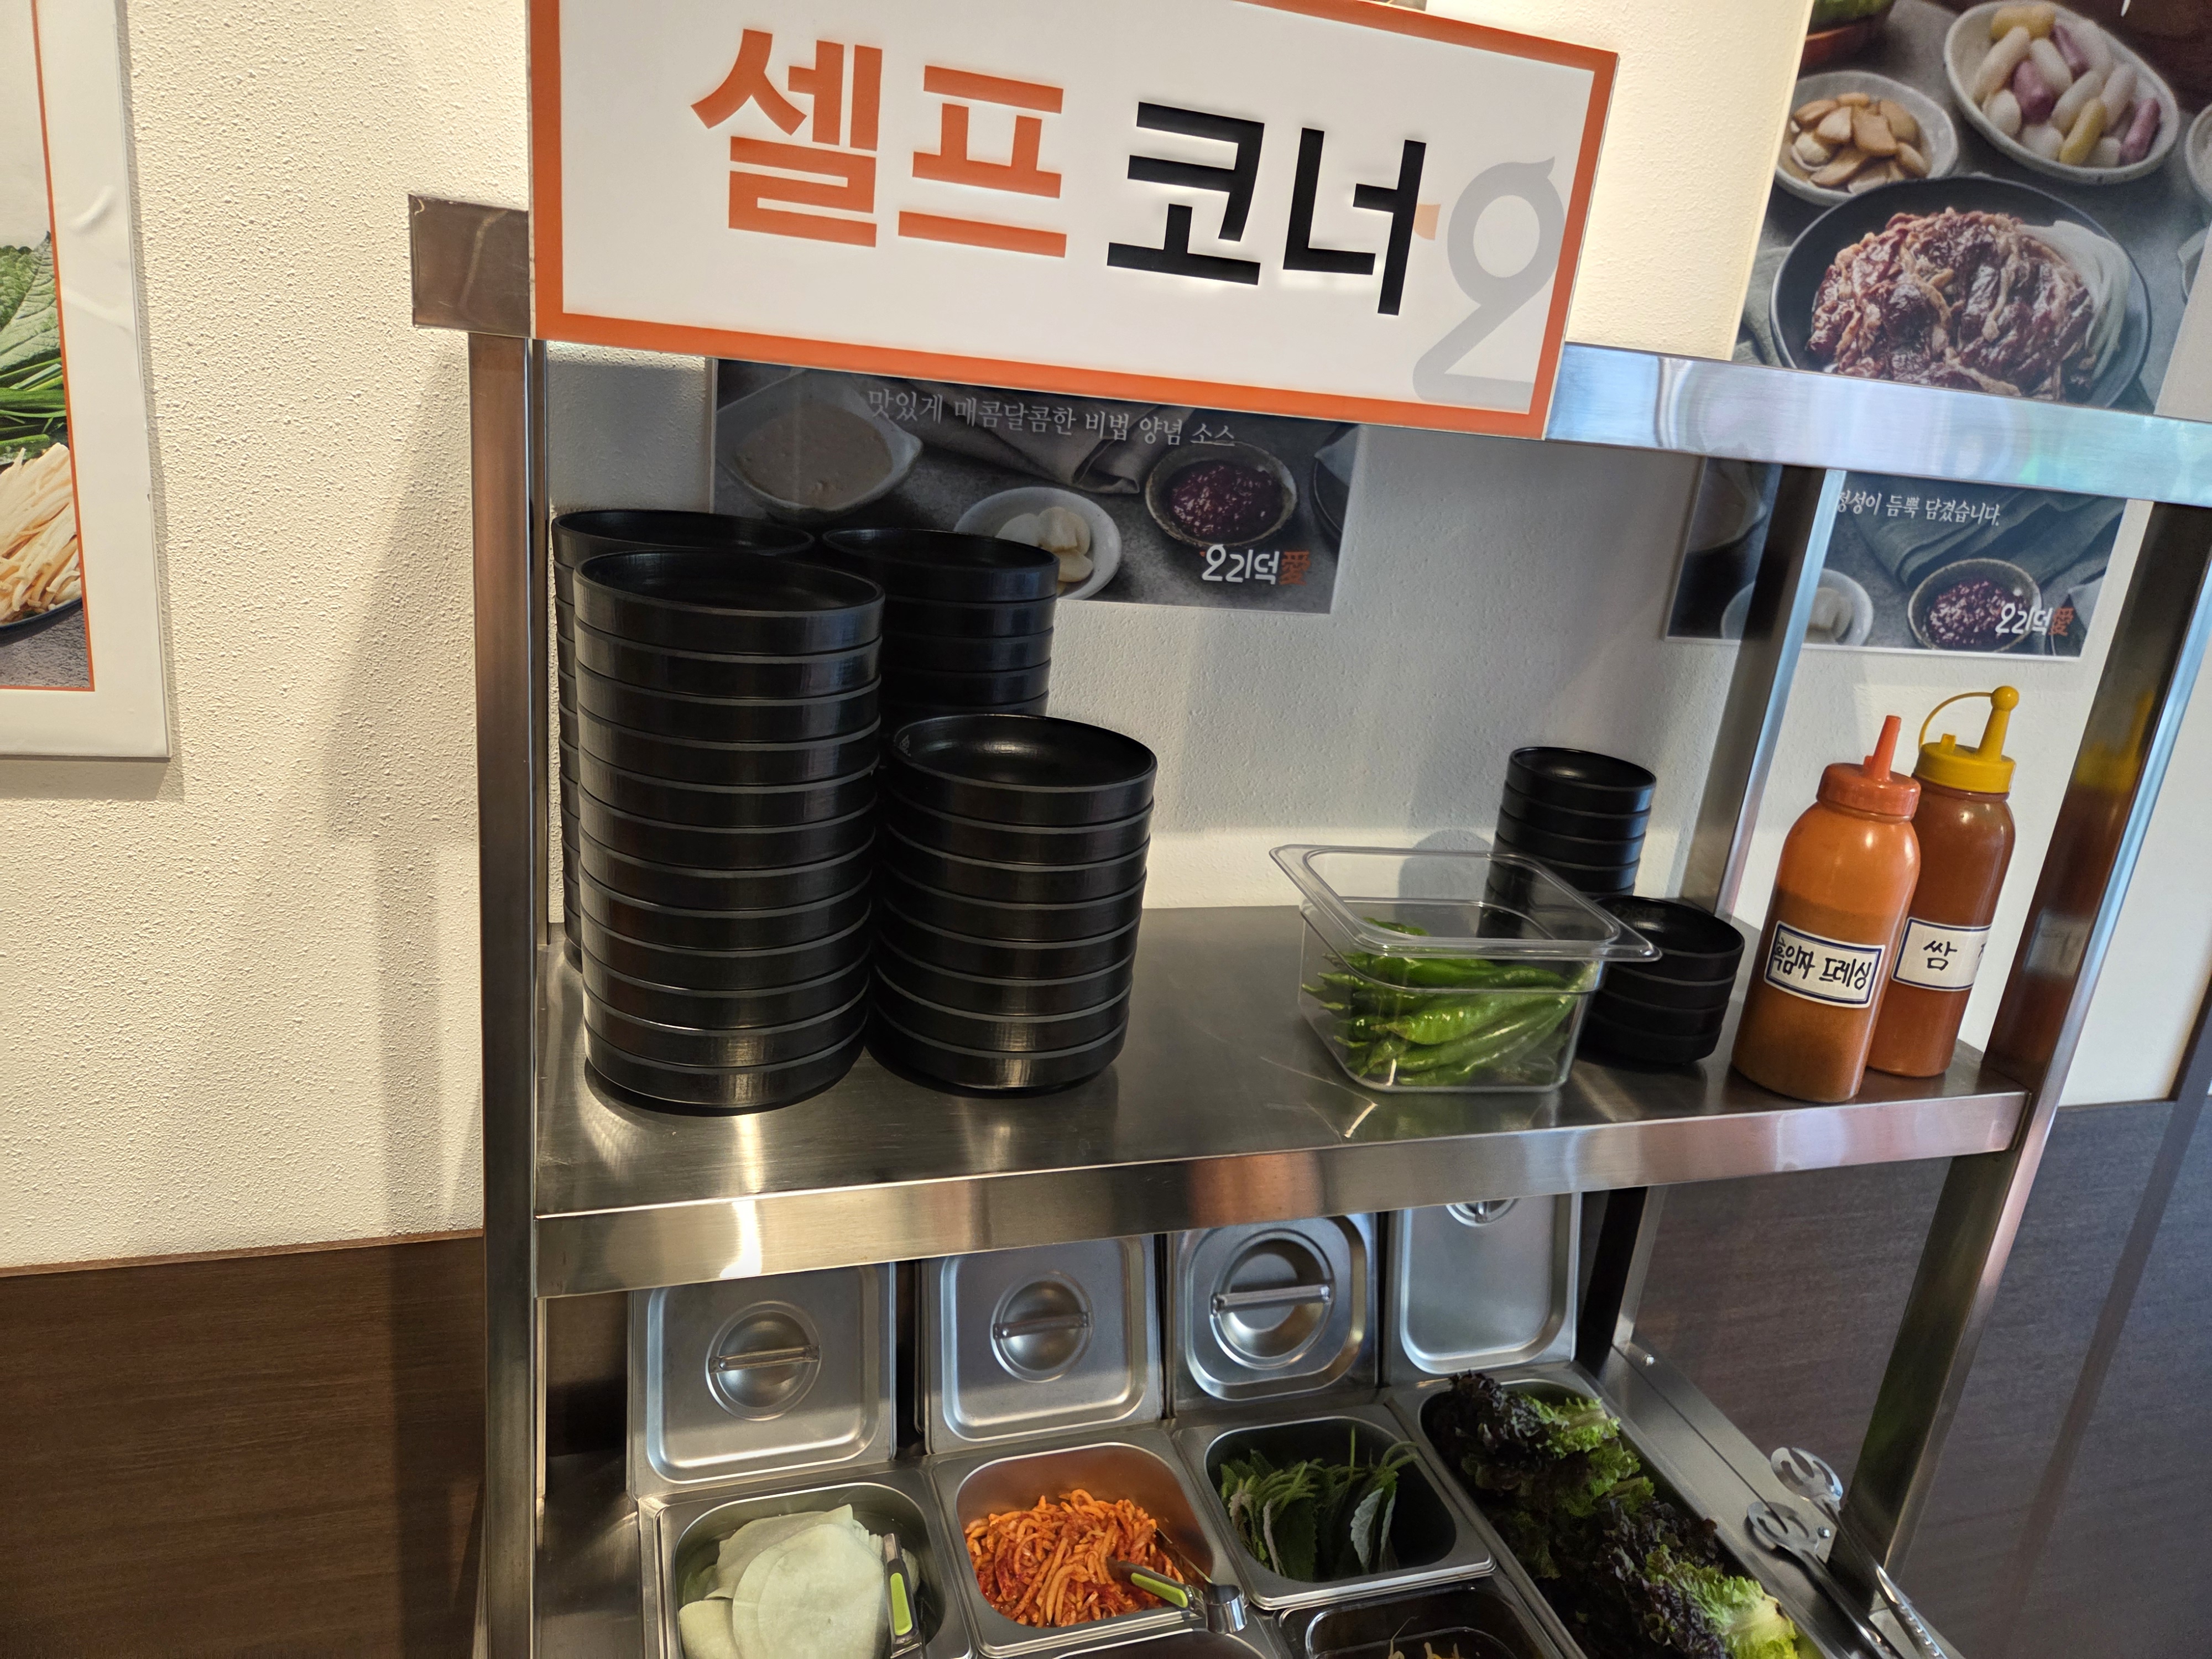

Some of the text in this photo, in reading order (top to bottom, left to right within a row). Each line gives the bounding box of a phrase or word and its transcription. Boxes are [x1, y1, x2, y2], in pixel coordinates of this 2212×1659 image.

[691, 28, 1427, 316] 셀프 코너
[868, 388, 1235, 447] 맛있게 매콤달콤한 비법 양념 소스
[1886, 495, 1919, 519] 듬뿍
[1774, 937, 1872, 990] 흑임자 드레싱
[1922, 940, 1958, 971] 쌈
